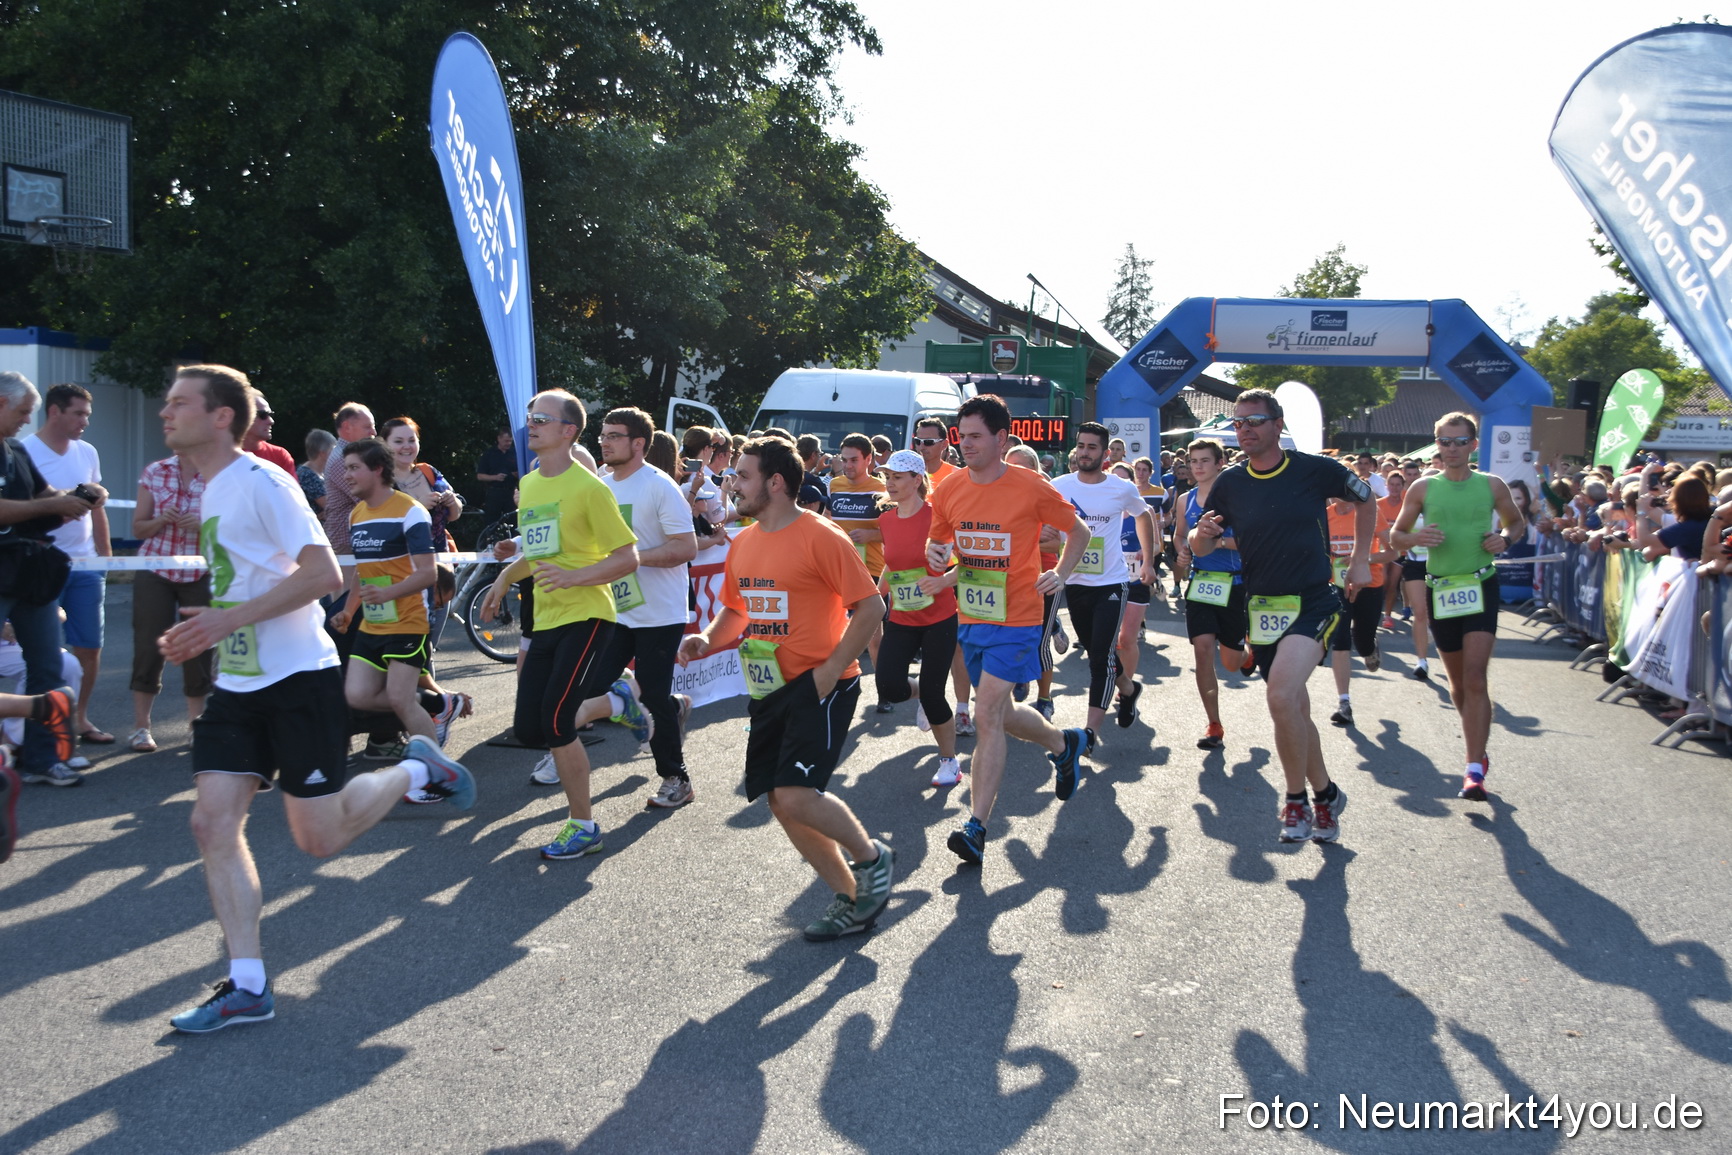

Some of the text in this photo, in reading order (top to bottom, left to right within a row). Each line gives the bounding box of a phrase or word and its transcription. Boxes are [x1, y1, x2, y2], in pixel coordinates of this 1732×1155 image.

[1297, 331, 1378, 347] firmenlauf
[1146, 356, 1189, 366] Fischer
[836, 502, 868, 511] Fischer
[960, 521, 1001, 531] 30 Jahre
[352, 538, 385, 548] Fischer
[526, 524, 551, 546] 657
[958, 535, 1006, 551] OBI
[1082, 551, 1100, 565] 63
[739, 577, 775, 588] 30 Jahre
[1197, 582, 1223, 597] 856
[897, 585, 924, 601] 974
[966, 588, 995, 607] 614
[1437, 589, 1478, 608] 1480
[1260, 614, 1290, 632] 836
[747, 663, 774, 684] 624
